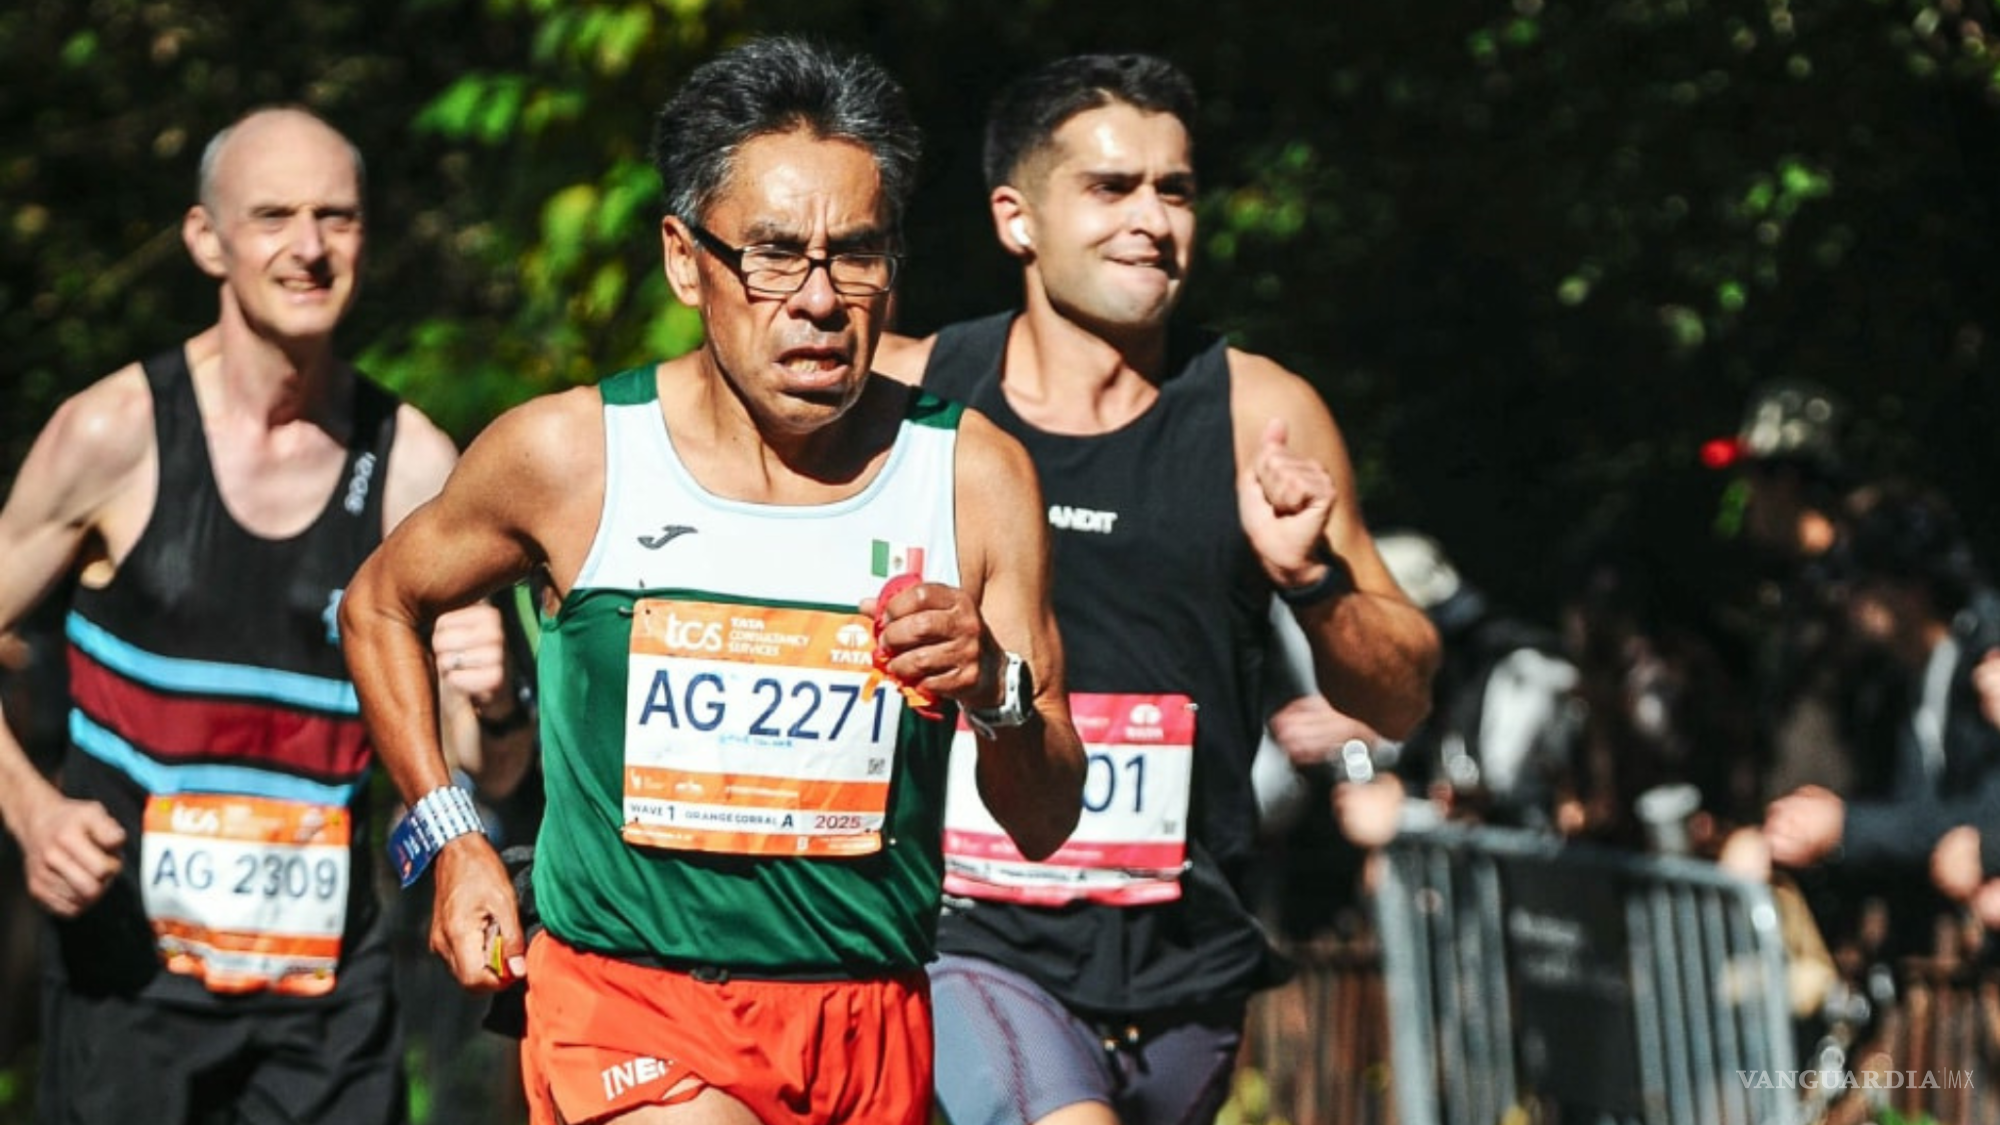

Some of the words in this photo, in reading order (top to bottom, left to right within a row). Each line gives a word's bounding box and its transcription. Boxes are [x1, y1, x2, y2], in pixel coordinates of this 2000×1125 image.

[664, 612, 724, 651] tcs
[730, 617, 765, 631] TATA
[830, 649, 873, 666] TATA
[638, 669, 726, 732] AG
[748, 678, 887, 744] 2271
[630, 803, 664, 817] WAVE
[667, 805, 675, 821] 1
[685, 809, 733, 823] ORANGE
[782, 813, 794, 829] A
[814, 814, 862, 830] 2025
[153, 848, 214, 890] AG
[232, 853, 338, 900] 2309
